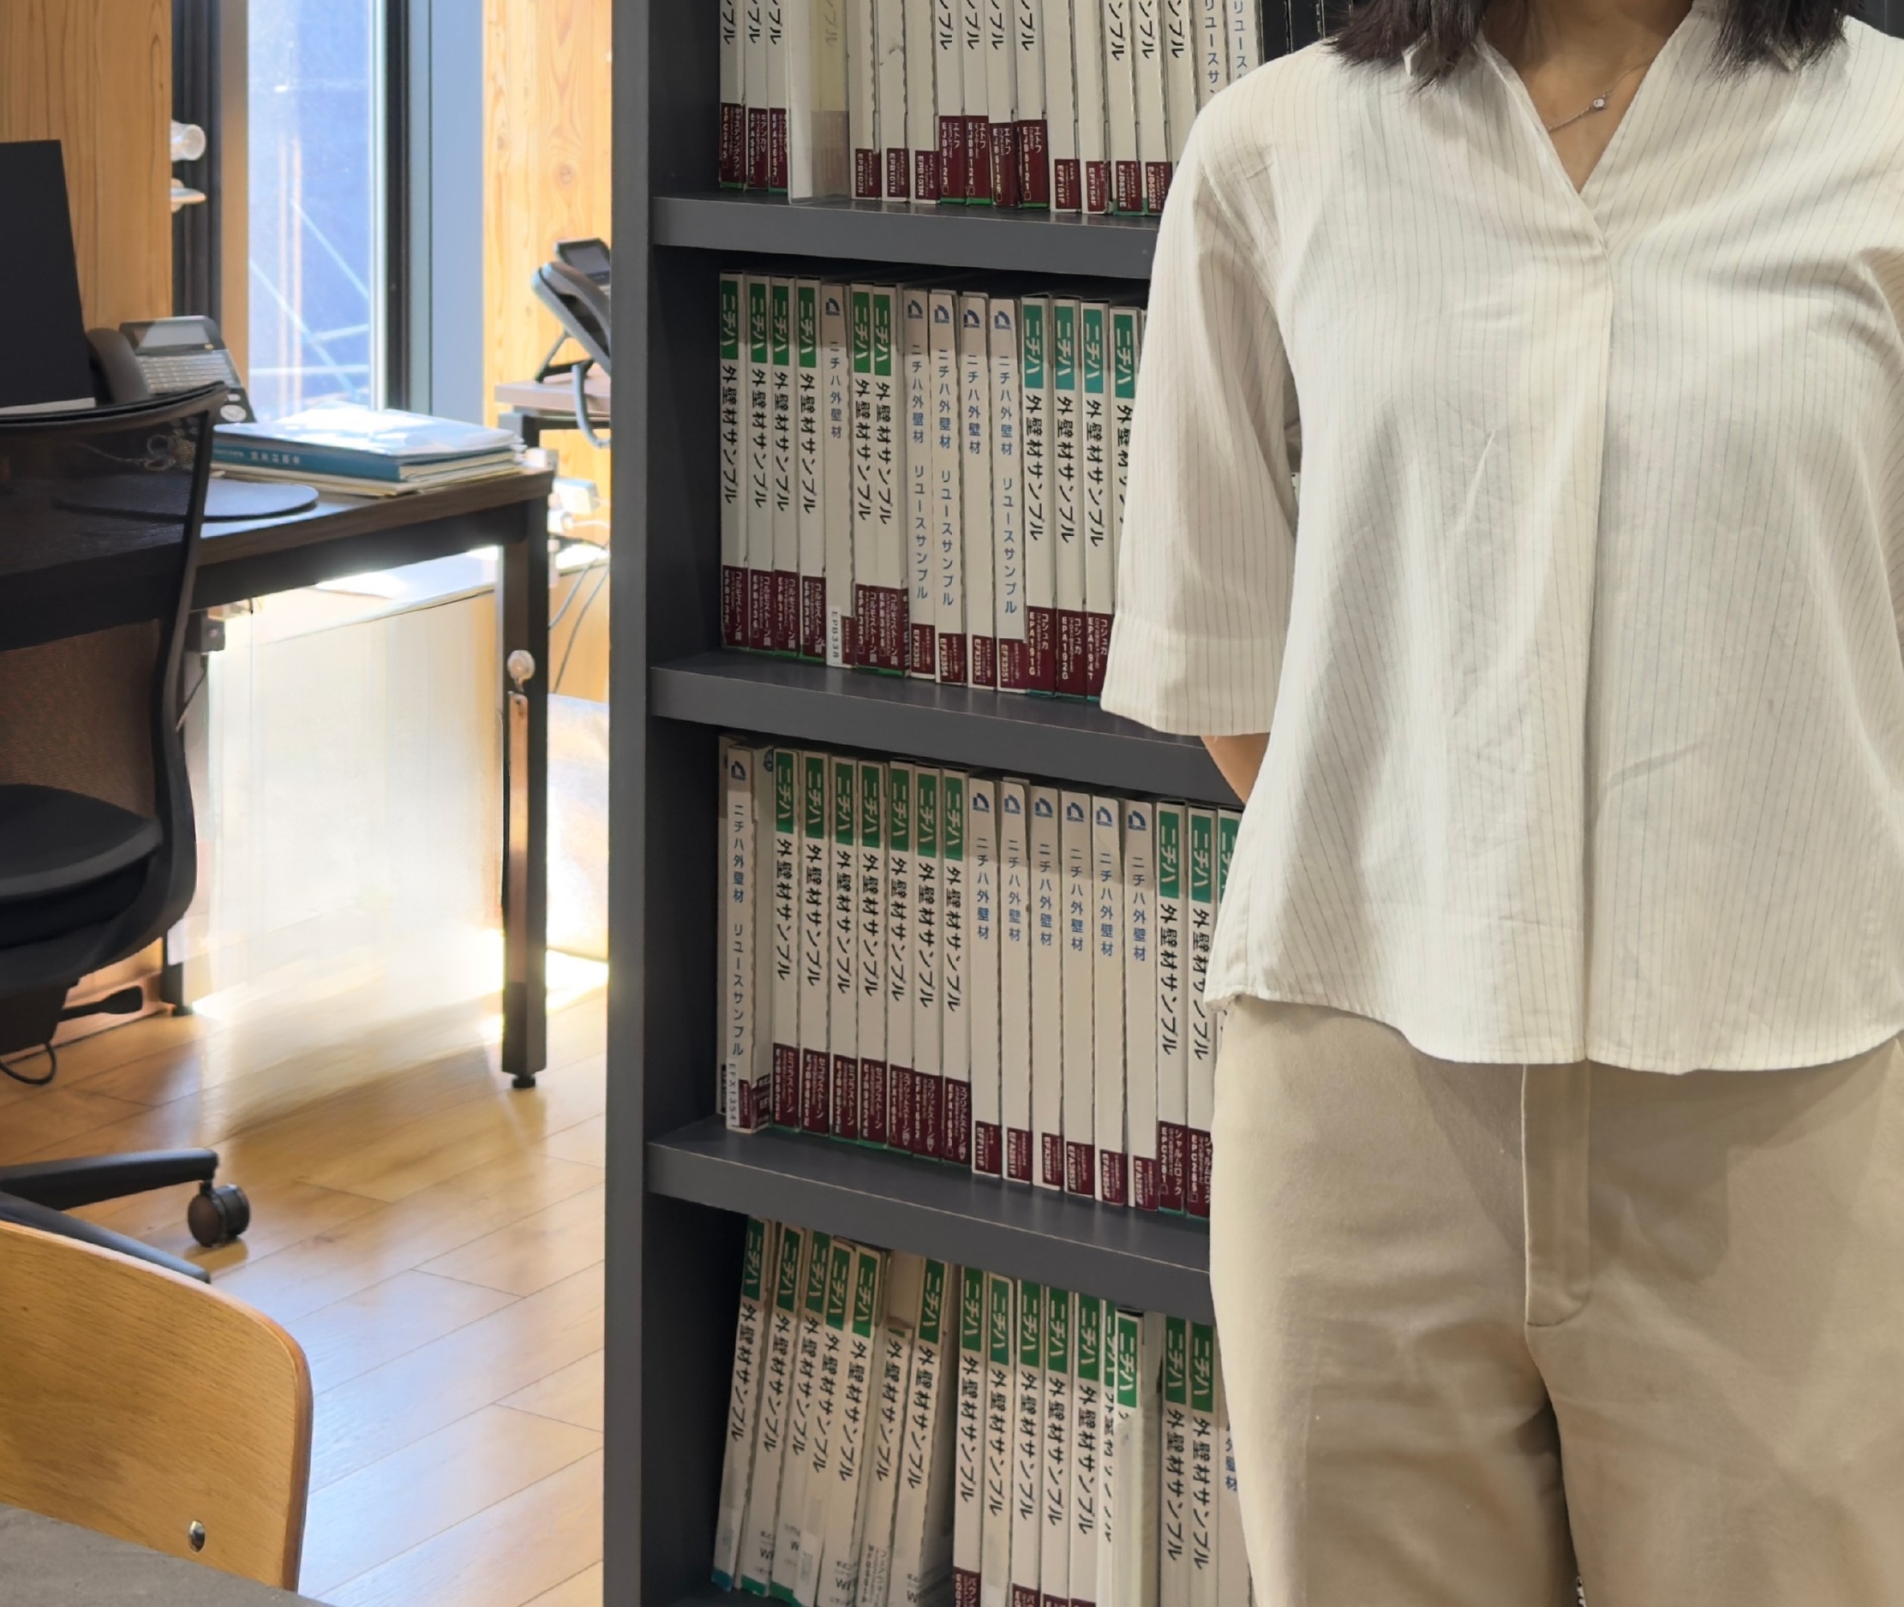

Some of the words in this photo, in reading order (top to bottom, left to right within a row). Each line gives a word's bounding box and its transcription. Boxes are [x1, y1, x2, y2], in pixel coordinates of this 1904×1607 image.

[876, 306, 889, 362] ニチハ
[938, 349, 952, 450] ニチハ外壁材
[876, 382, 892, 525] 外壁材サンプル
[1027, 395, 1044, 542] 外壁材サンプル
[941, 469, 955, 607] リユースサンプル
[976, 838, 990, 941] ニチハ外壁材
[1161, 904, 1179, 1056] 外壁材サンプル
[960, 1356, 979, 1503] 外壁材サンプル
